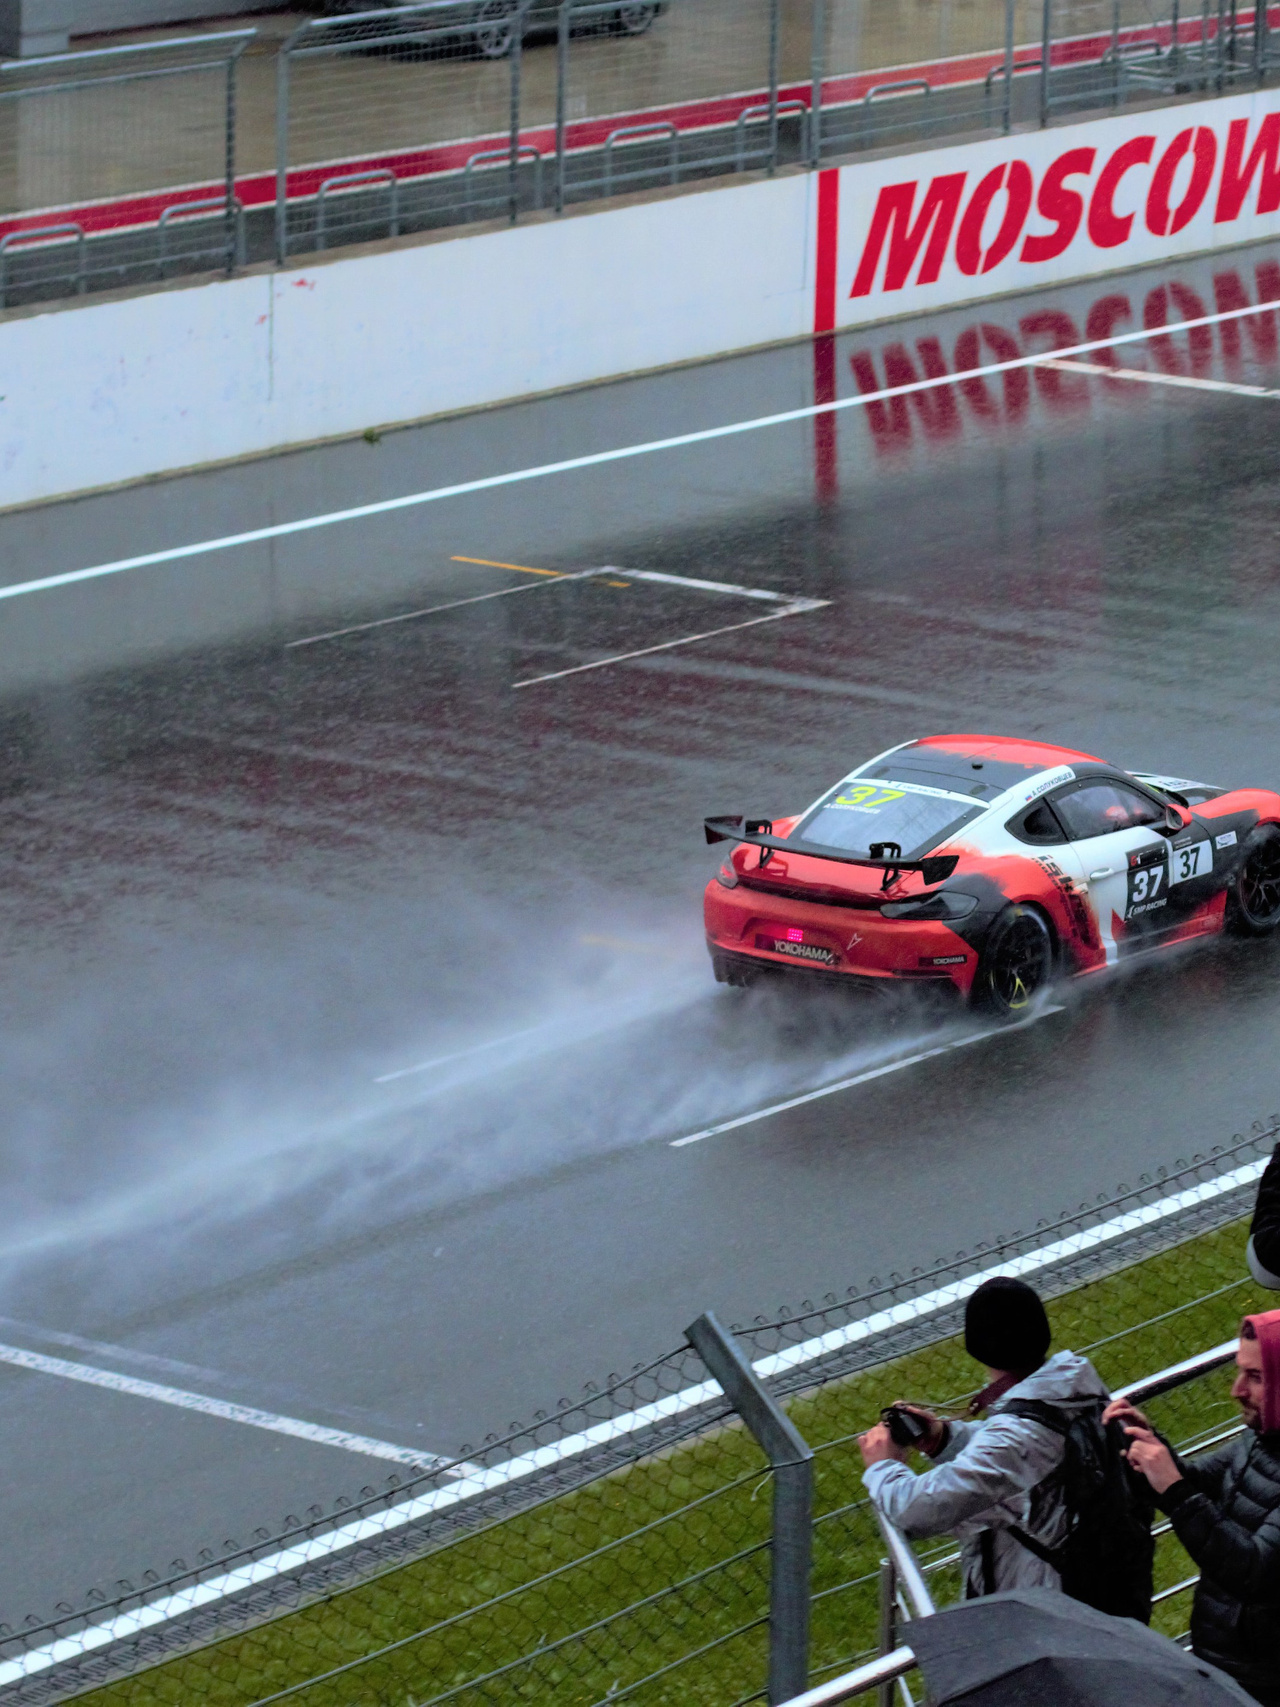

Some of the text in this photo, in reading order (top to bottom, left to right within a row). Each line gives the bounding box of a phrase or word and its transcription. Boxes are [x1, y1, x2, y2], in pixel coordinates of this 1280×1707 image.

[836, 786, 907, 808] 37
[1180, 846, 1201, 879] 37
[1133, 865, 1164, 902] 37
[1133, 898, 1168, 915] SMP RACING
[775, 940, 830, 961] YOKOHAMA
[933, 956, 964, 965] YOKOHAMA
